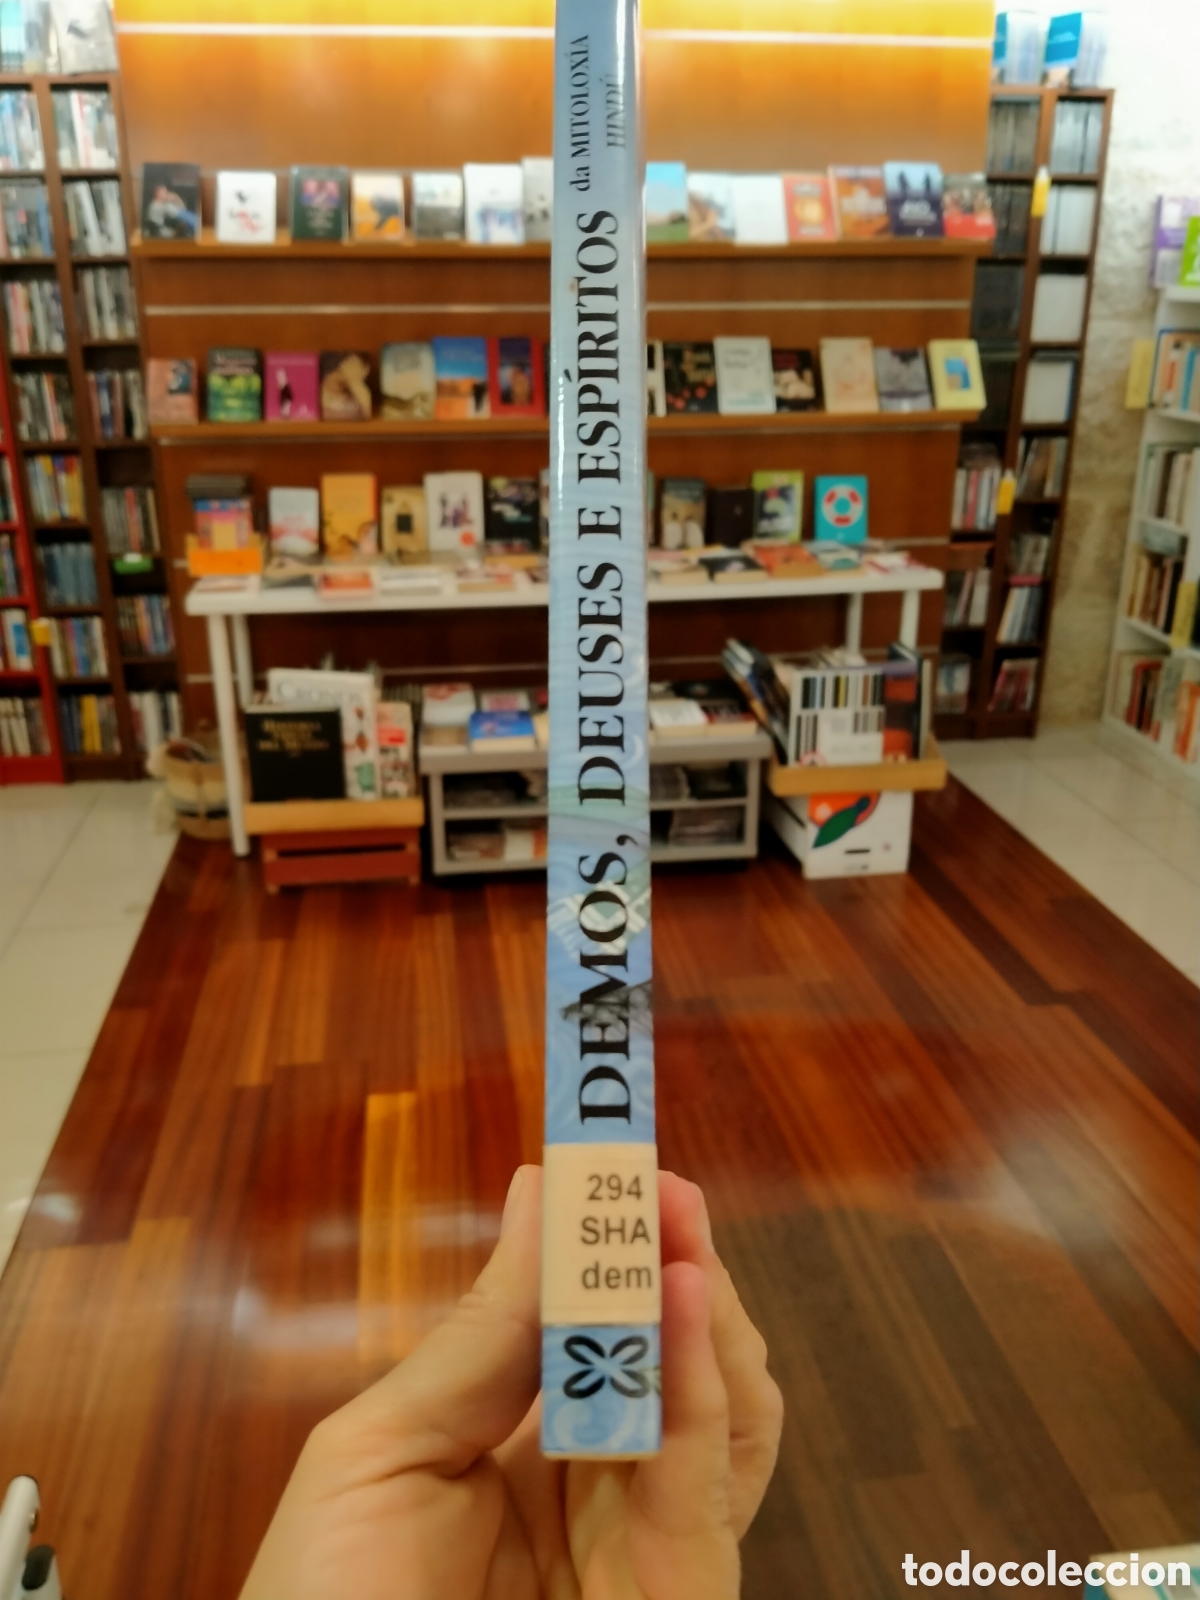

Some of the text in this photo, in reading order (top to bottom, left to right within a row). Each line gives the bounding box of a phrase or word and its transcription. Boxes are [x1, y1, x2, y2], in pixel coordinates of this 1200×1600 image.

[564, 35, 591, 192] da MITOLOXÍA
[564, 210, 638, 1125] DEMOS, DEUSES E ESPÍRITOS
[587, 1173, 643, 1201] 294
[580, 1216, 651, 1246] SHA
[581, 1262, 653, 1290] dem
